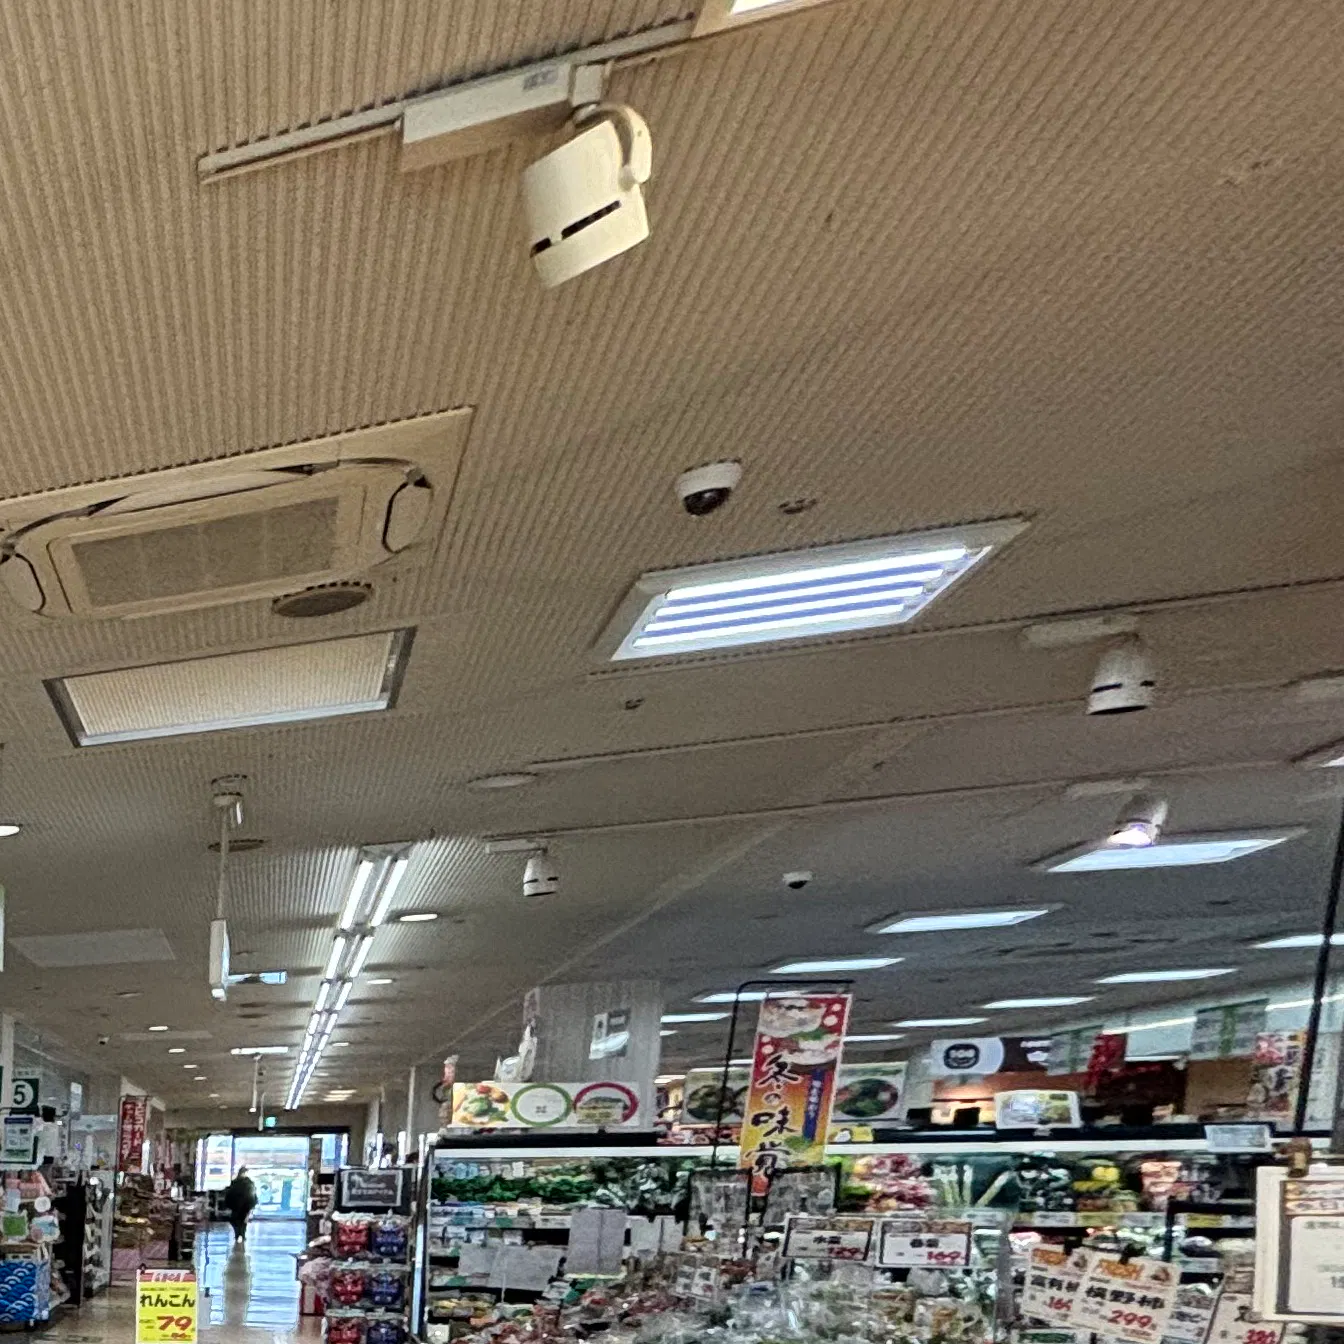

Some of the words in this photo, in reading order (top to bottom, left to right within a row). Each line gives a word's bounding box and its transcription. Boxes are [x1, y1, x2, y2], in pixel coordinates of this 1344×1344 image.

[14, 1083, 28, 1104] 5
[140, 1294, 195, 1308] れんこん
[157, 1316, 192, 1331] 79
[1108, 1309, 1153, 1328] 299
